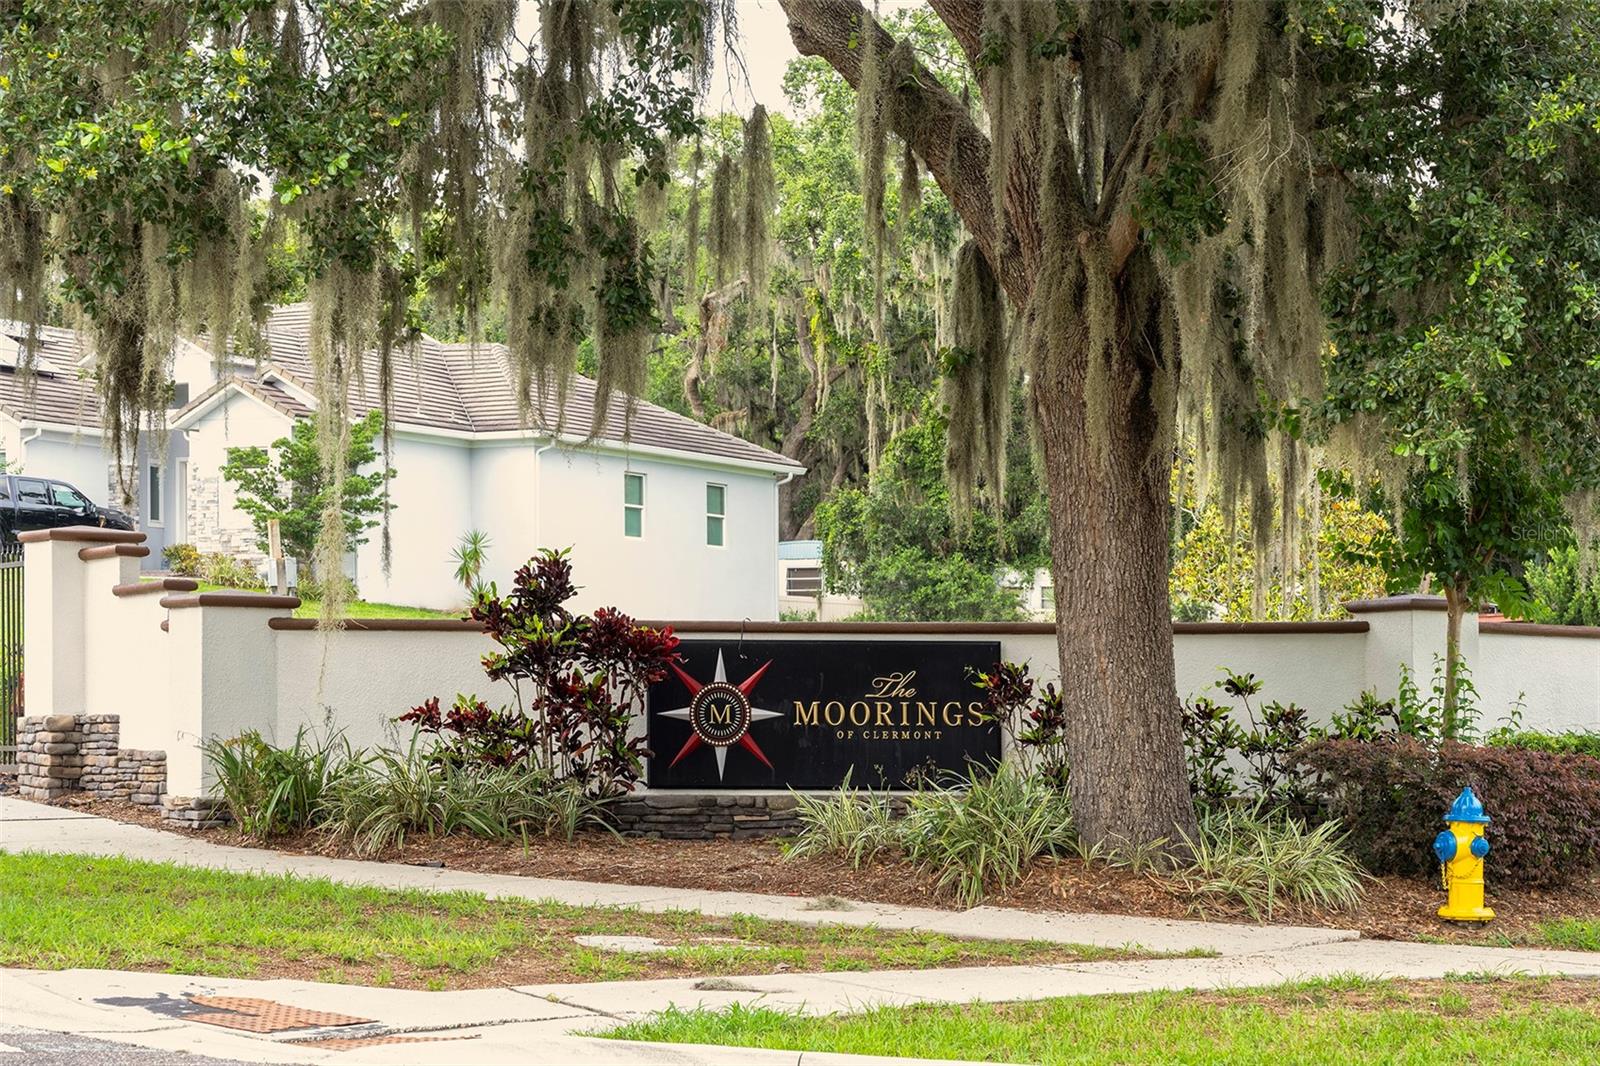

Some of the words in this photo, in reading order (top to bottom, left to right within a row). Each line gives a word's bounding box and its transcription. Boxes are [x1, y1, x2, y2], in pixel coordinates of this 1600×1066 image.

[865, 670, 917, 698] The
[708, 704, 732, 724] M
[793, 701, 985, 727] MOORINGS
[836, 730, 854, 740] OF
[863, 730, 942, 740] CLERMONT
